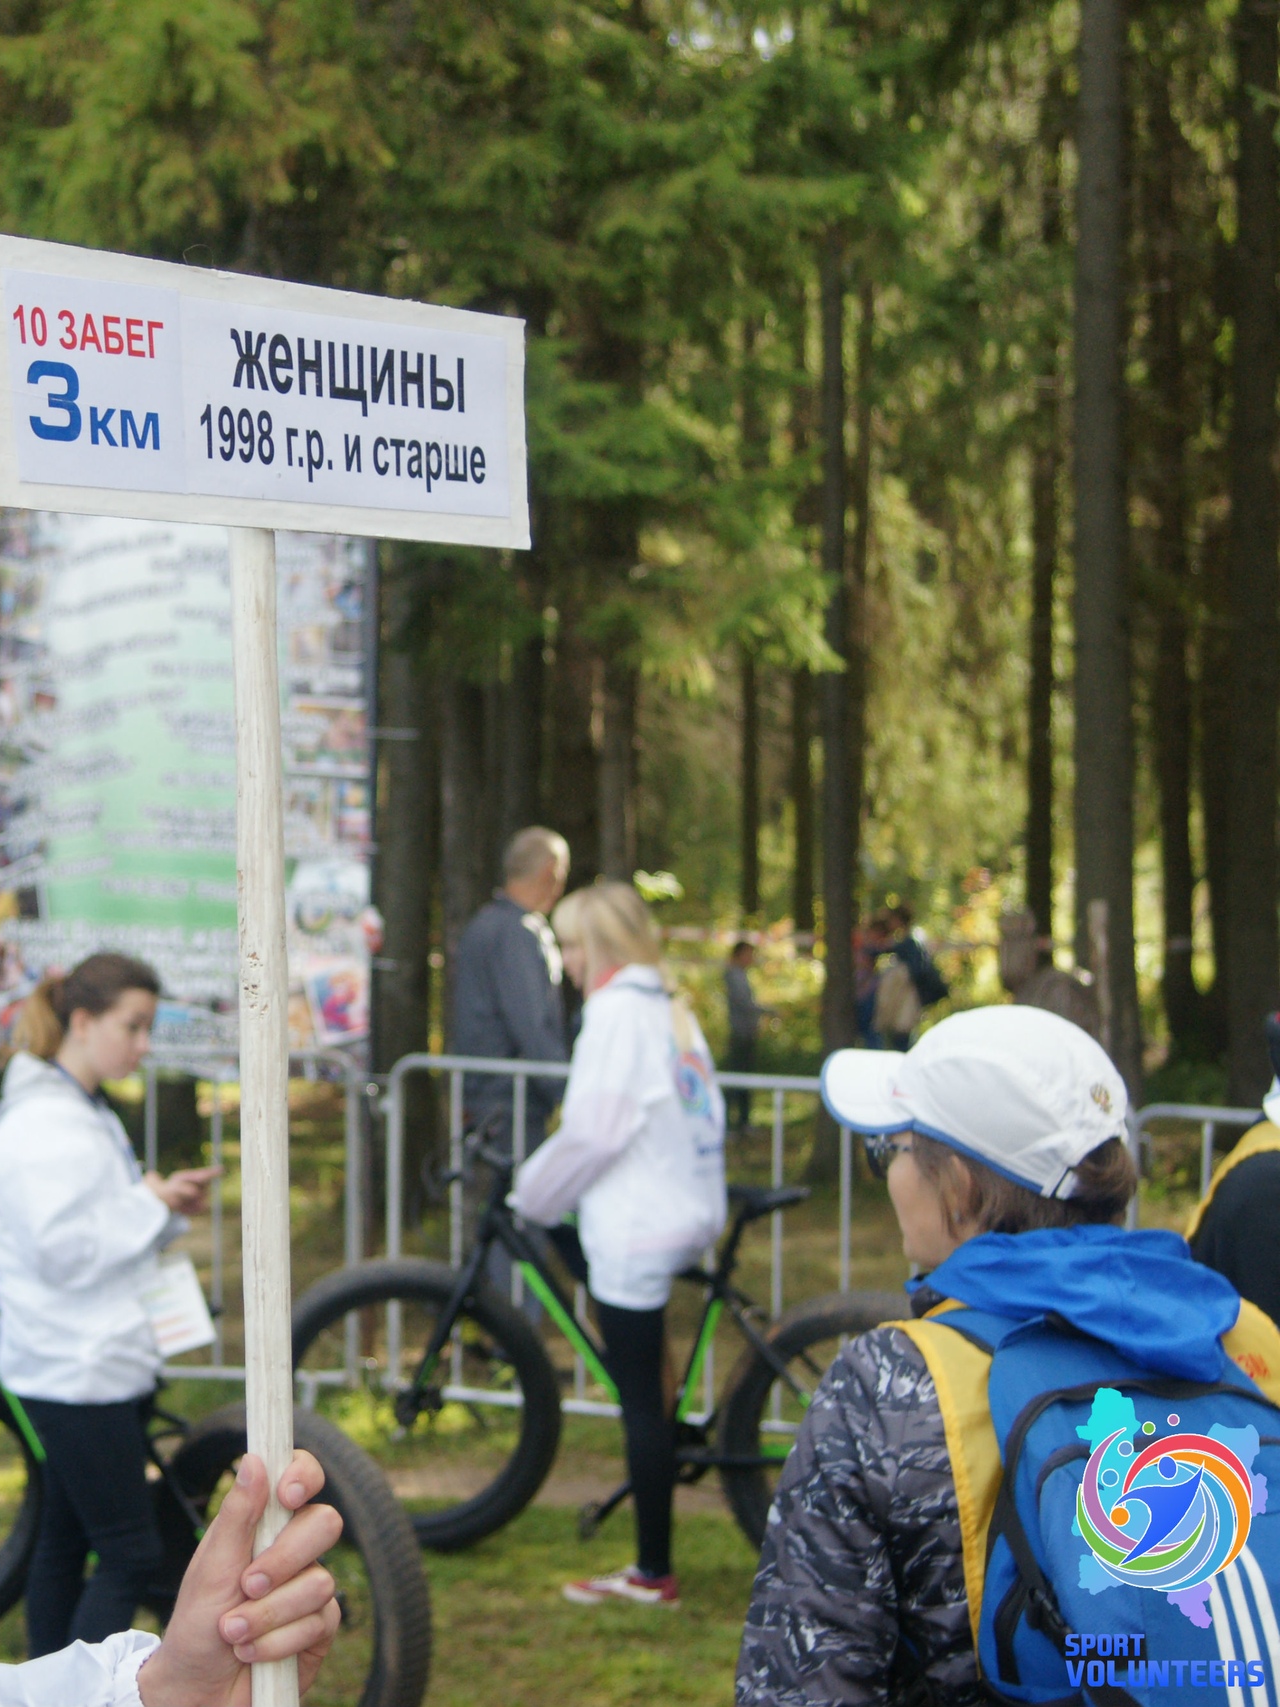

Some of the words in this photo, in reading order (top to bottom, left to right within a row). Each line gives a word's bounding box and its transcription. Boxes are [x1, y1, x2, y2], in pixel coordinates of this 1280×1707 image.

[13, 304, 47, 347] 10
[58, 309, 164, 359] ЗАБЕГ
[200, 403, 275, 466] 1998
[286, 427, 333, 483] г.р.
[344, 433, 362, 473] и
[373, 436, 487, 494] старше
